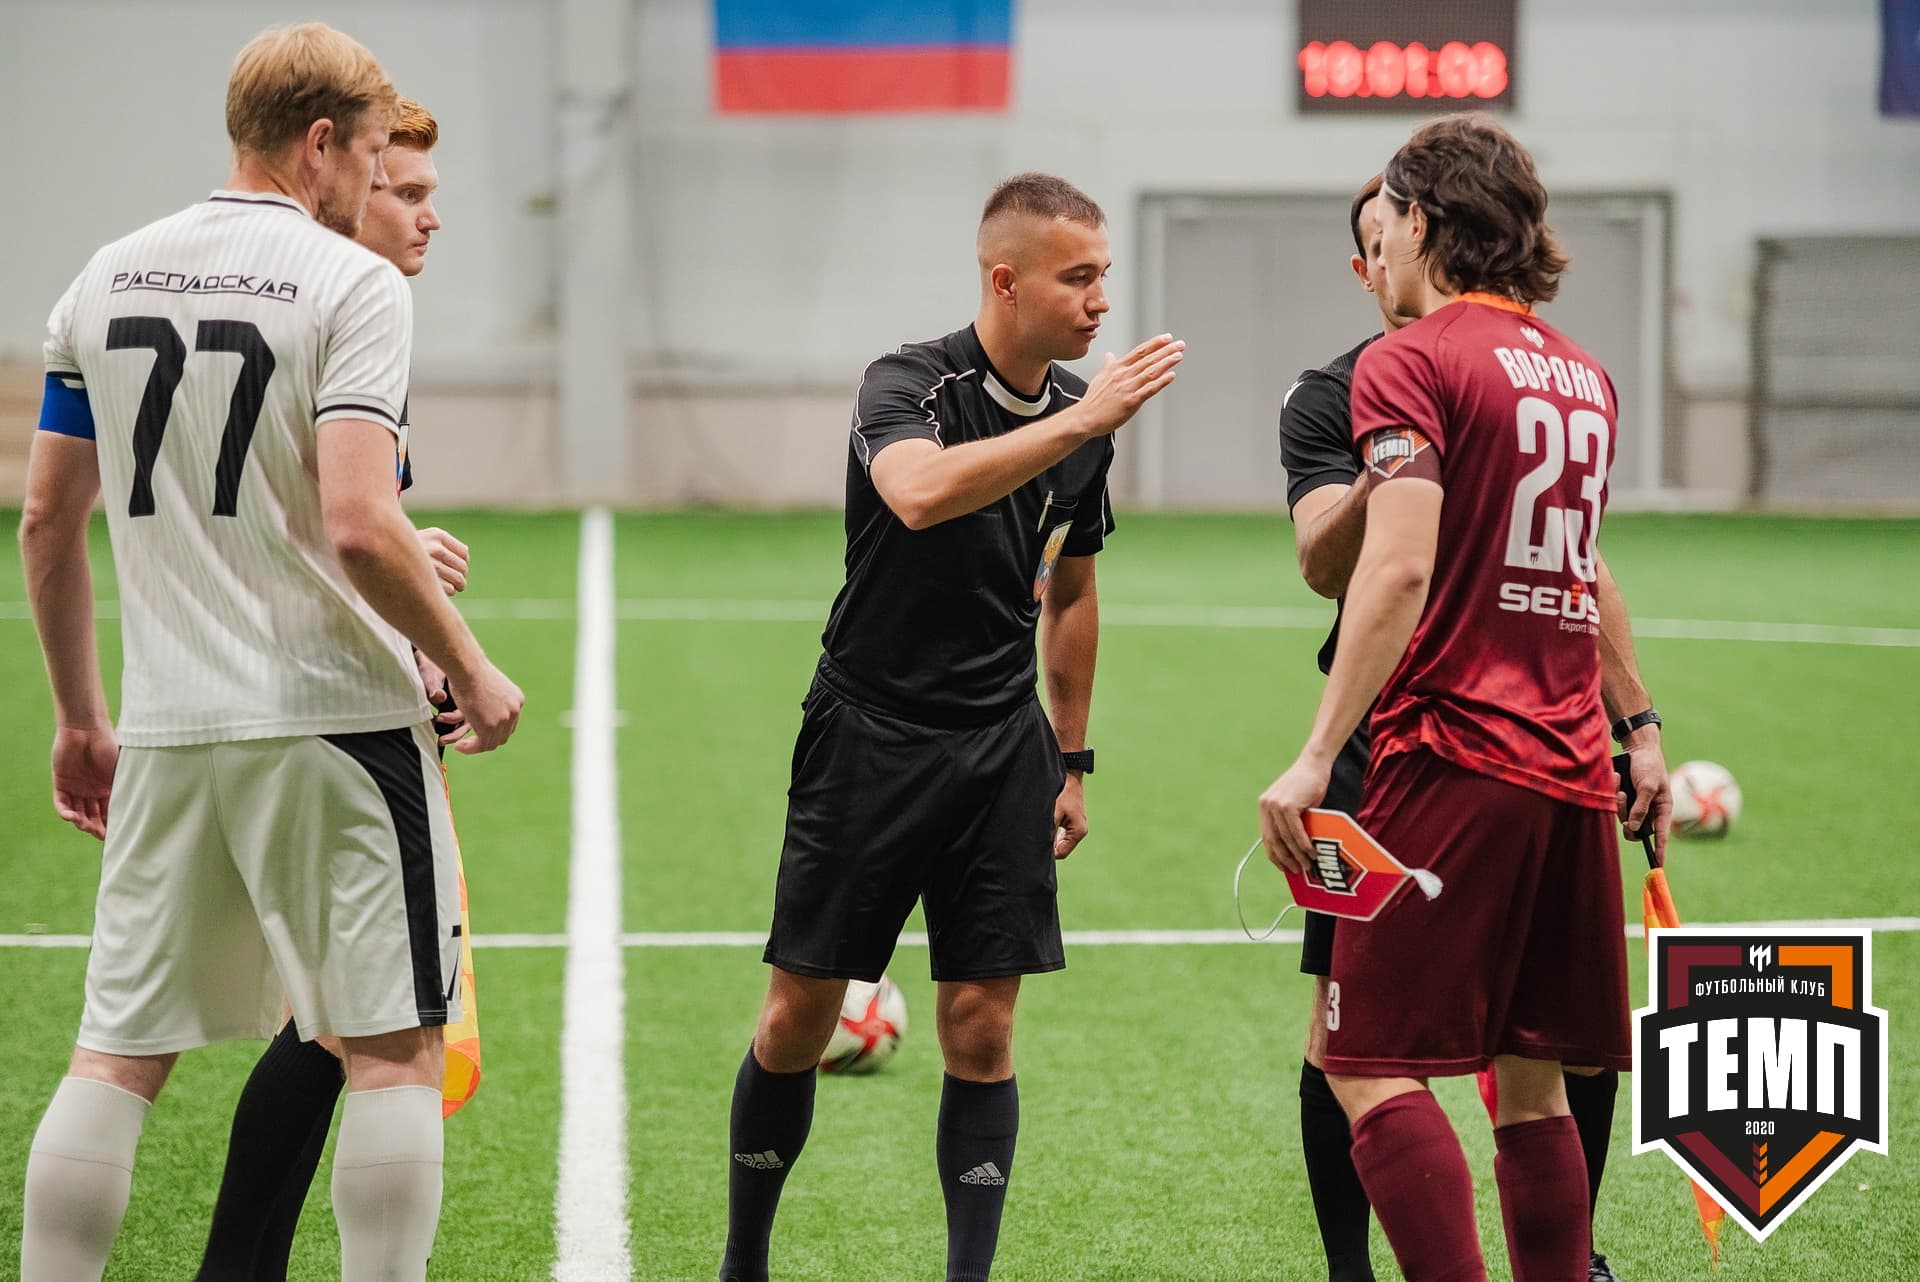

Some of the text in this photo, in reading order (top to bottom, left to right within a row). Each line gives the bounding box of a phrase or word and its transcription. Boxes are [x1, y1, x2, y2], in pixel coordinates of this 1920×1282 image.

[1493, 347, 1607, 411] ВОРОНА
[106, 316, 275, 518] 77
[1373, 438, 1410, 464] ТЕМП
[1504, 396, 1609, 583] 23
[1559, 619, 1587, 633] Export
[1315, 842, 1347, 889] ТЕМП
[734, 1153, 785, 1169] adidas
[959, 1174, 1006, 1185] adidas
